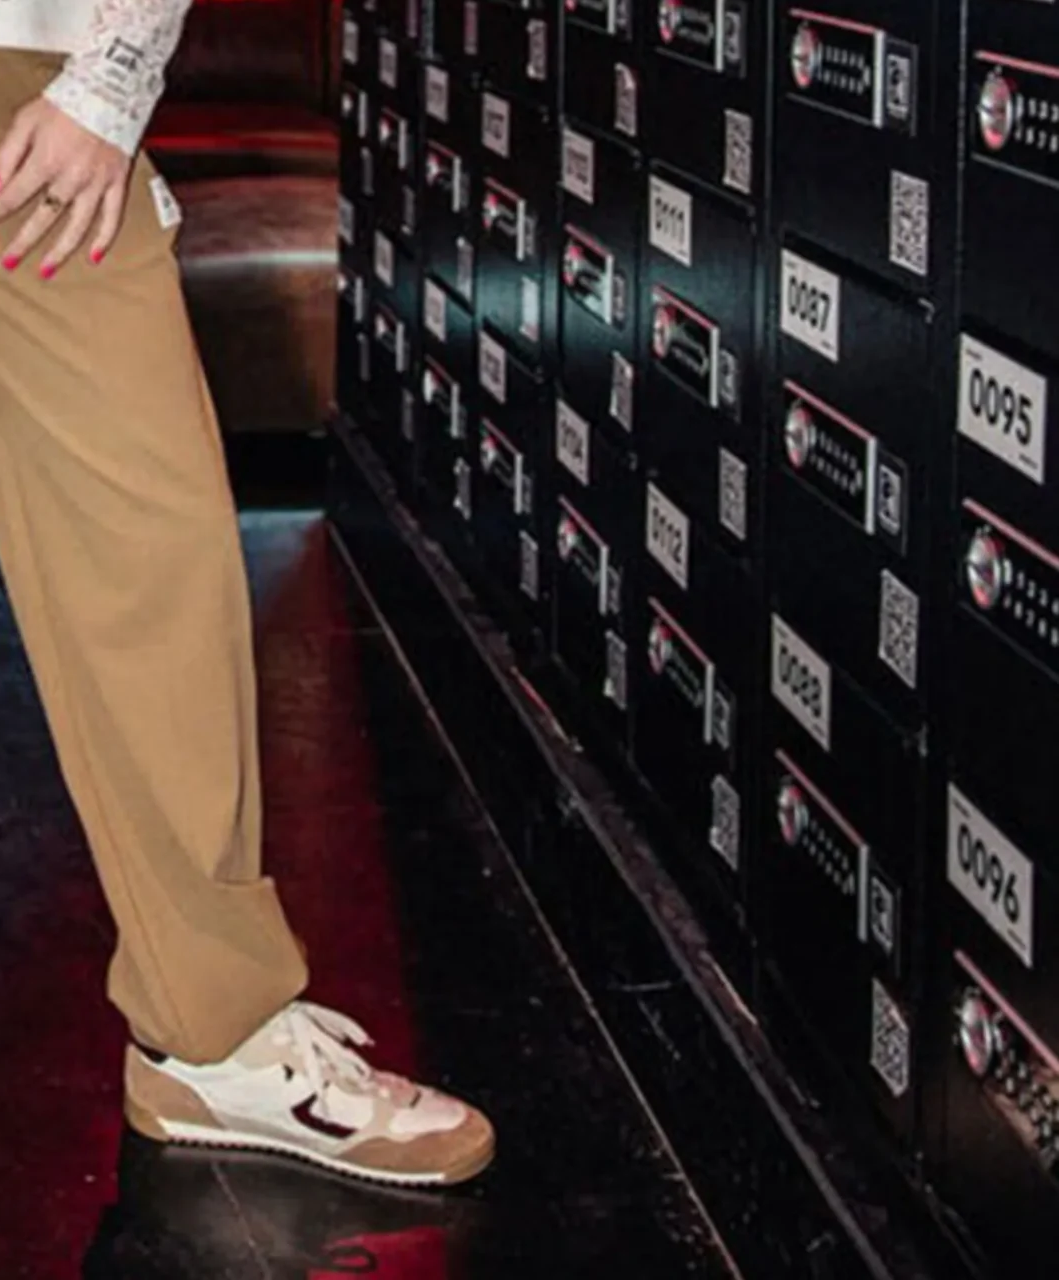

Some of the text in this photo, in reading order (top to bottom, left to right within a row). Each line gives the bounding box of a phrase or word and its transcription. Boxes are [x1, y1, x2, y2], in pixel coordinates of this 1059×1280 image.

[654, 196, 685, 246] 0111
[789, 276, 830, 331] 0087
[970, 369, 1031, 445] 0095
[652, 507, 682, 564] 0112
[958, 824, 1019, 923] 0096
